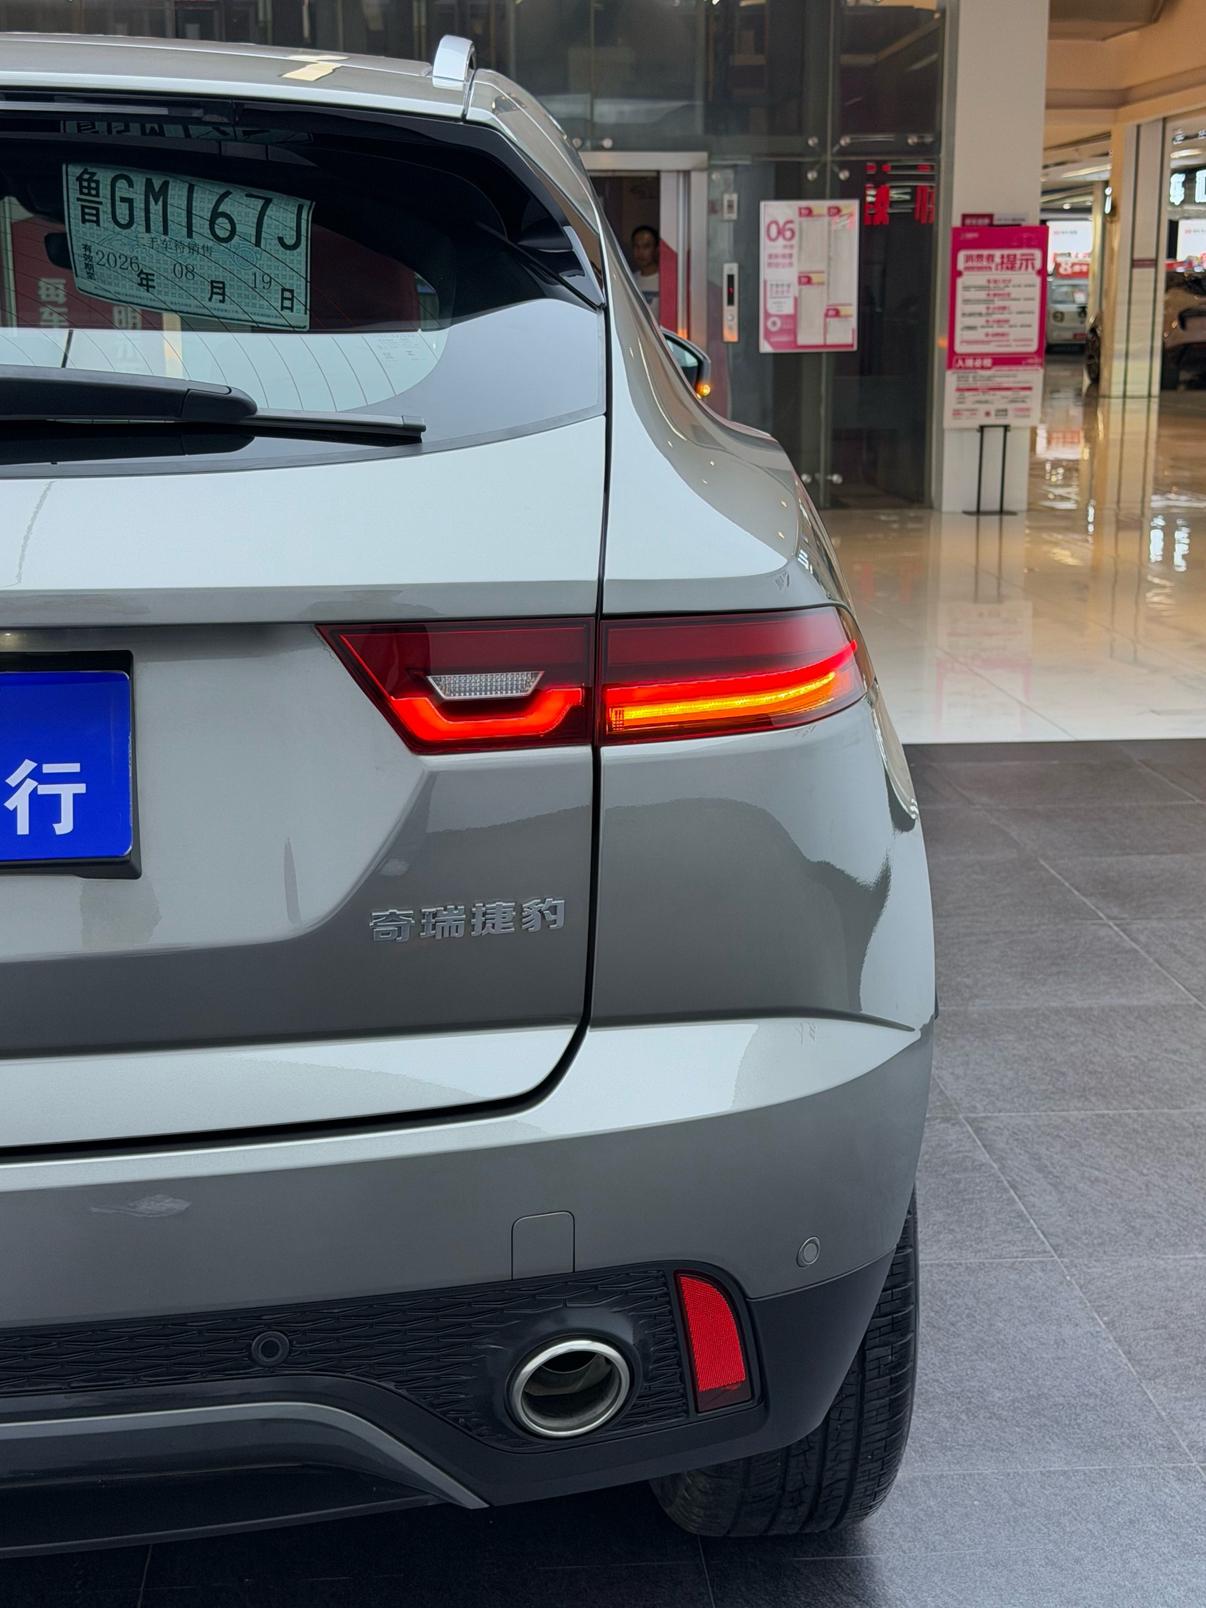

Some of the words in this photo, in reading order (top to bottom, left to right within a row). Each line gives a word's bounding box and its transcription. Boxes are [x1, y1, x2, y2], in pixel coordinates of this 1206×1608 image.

[76, 168, 303, 250] 鲁GM167J
[766, 220, 796, 242] 06
[95, 250, 141, 273] 2026
[137, 269, 156, 292] 年
[173, 262, 196, 281] 08
[208, 280, 227, 303] 月
[252, 272, 272, 290] 19
[280, 288, 295, 313] 日
[1000, 253, 1036, 271] 提示
[3, 758, 87, 836] 行
[369, 897, 566, 943] 奇瑞捷豹
